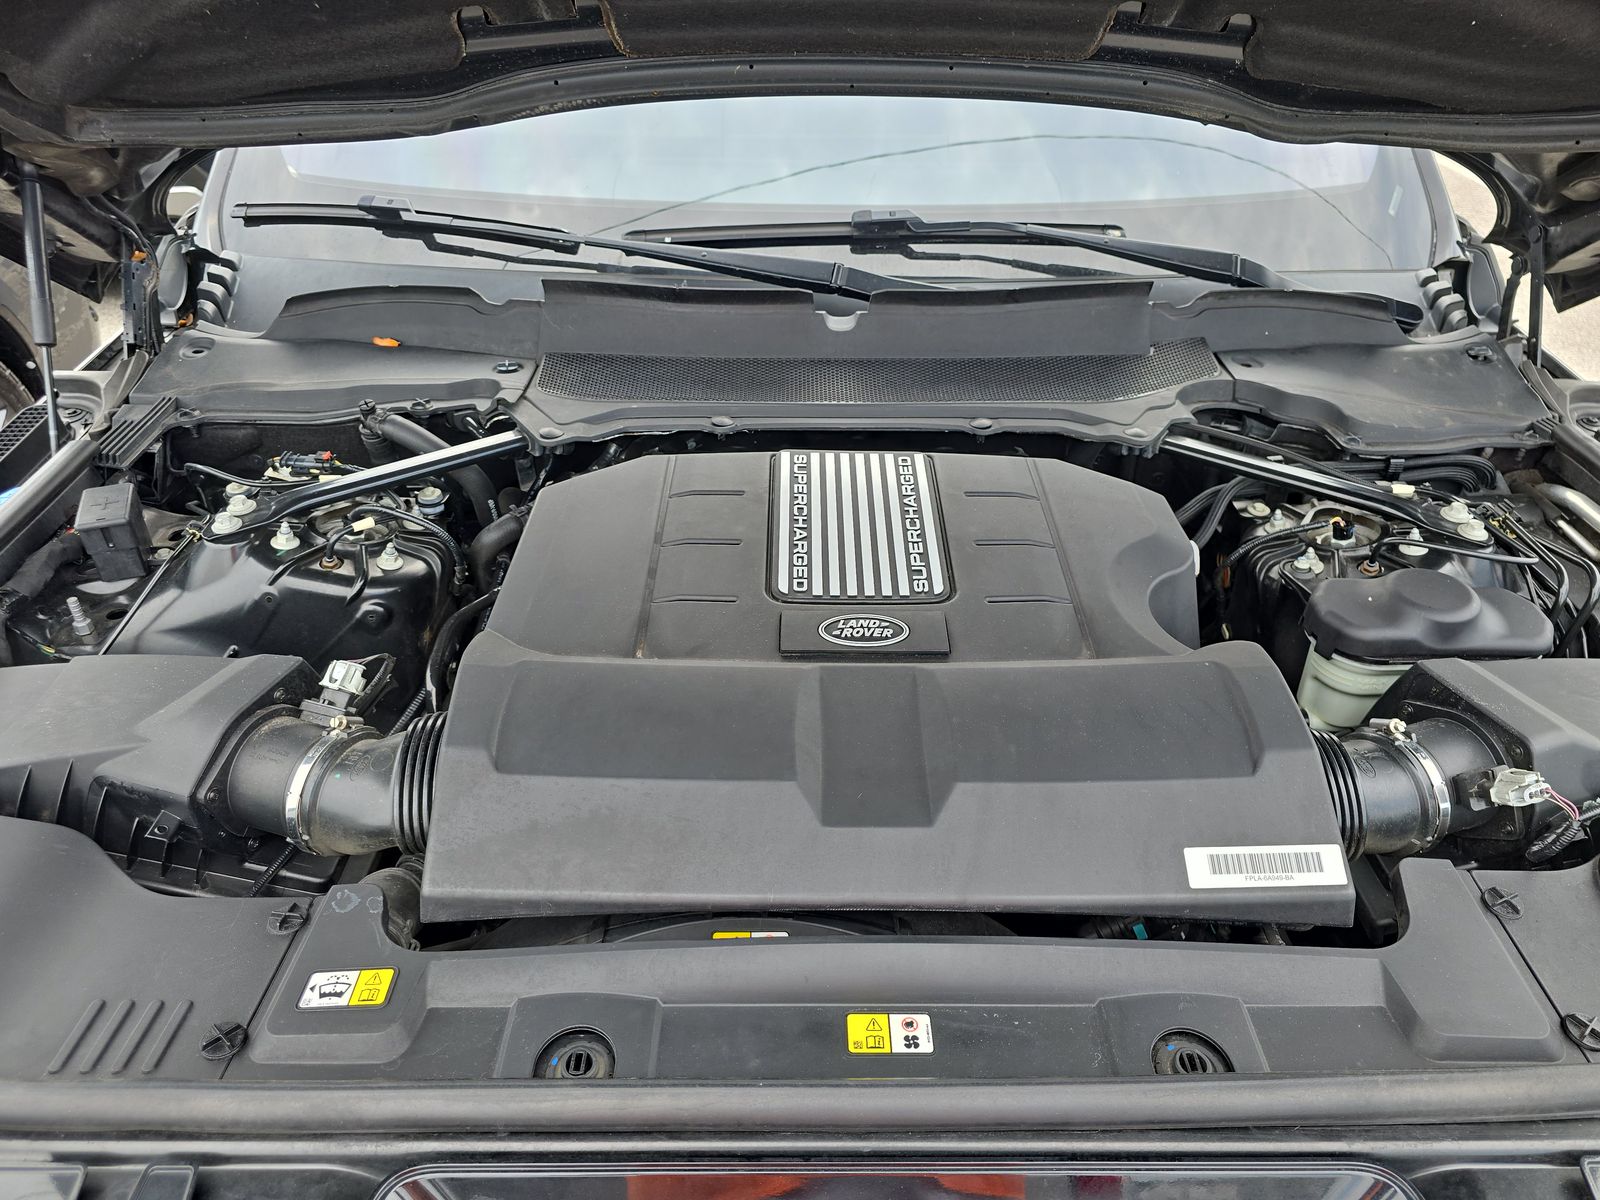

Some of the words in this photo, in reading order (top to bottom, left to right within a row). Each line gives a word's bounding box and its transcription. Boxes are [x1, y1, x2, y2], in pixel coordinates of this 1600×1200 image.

[793, 454, 808, 592] SUPERCHARGED
[898, 456, 929, 593] SUPERCHARGED
[837, 619, 880, 628] LAND
[841, 628, 894, 638] ROVER
